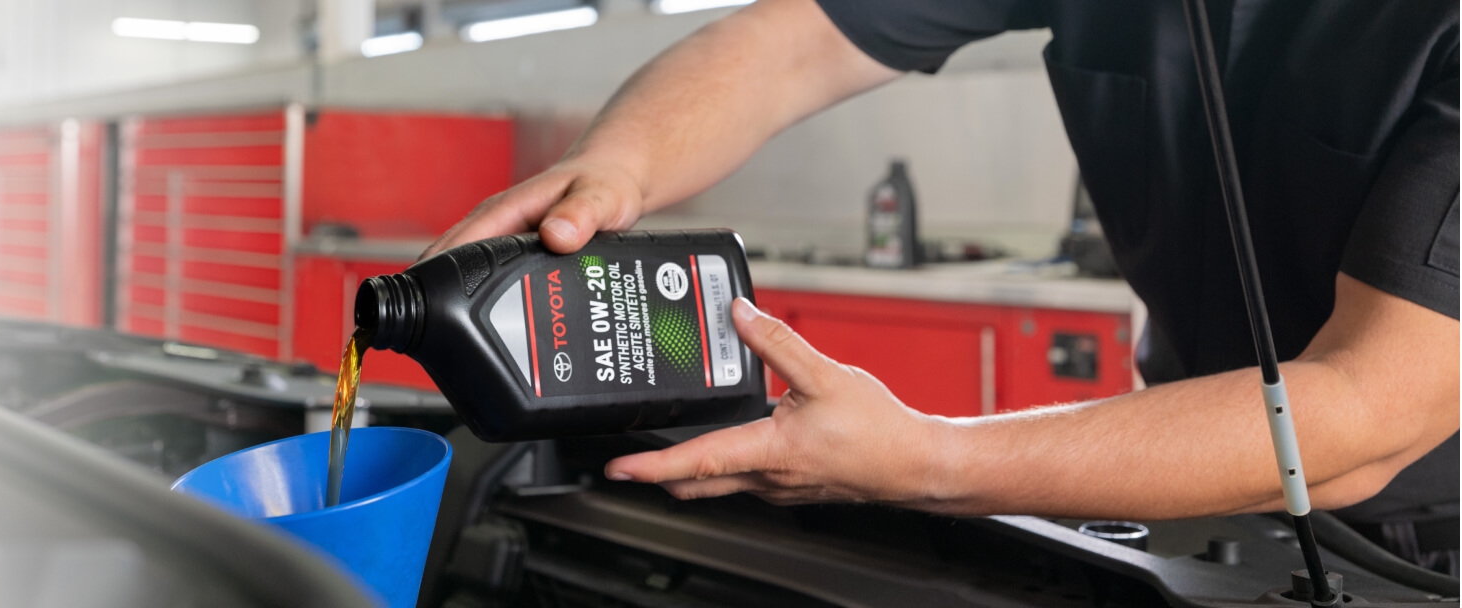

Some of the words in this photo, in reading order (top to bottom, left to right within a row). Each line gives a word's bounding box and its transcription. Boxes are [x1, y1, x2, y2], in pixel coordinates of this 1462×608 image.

[608, 262, 620, 279] OIL
[635, 260, 647, 295] gasolina
[547, 269, 568, 350] TOYOTA
[586, 265, 611, 333] 0W-20
[610, 281, 626, 321] MOTOR
[623, 274, 642, 331] SINTÉTICO
[641, 302, 652, 337] motores
[593, 338, 615, 382] SAE
[615, 322, 632, 385] SYNTHETIC
[630, 332, 645, 371] ACEITE
[645, 338, 655, 358] para
[645, 358, 656, 386] Aceite
